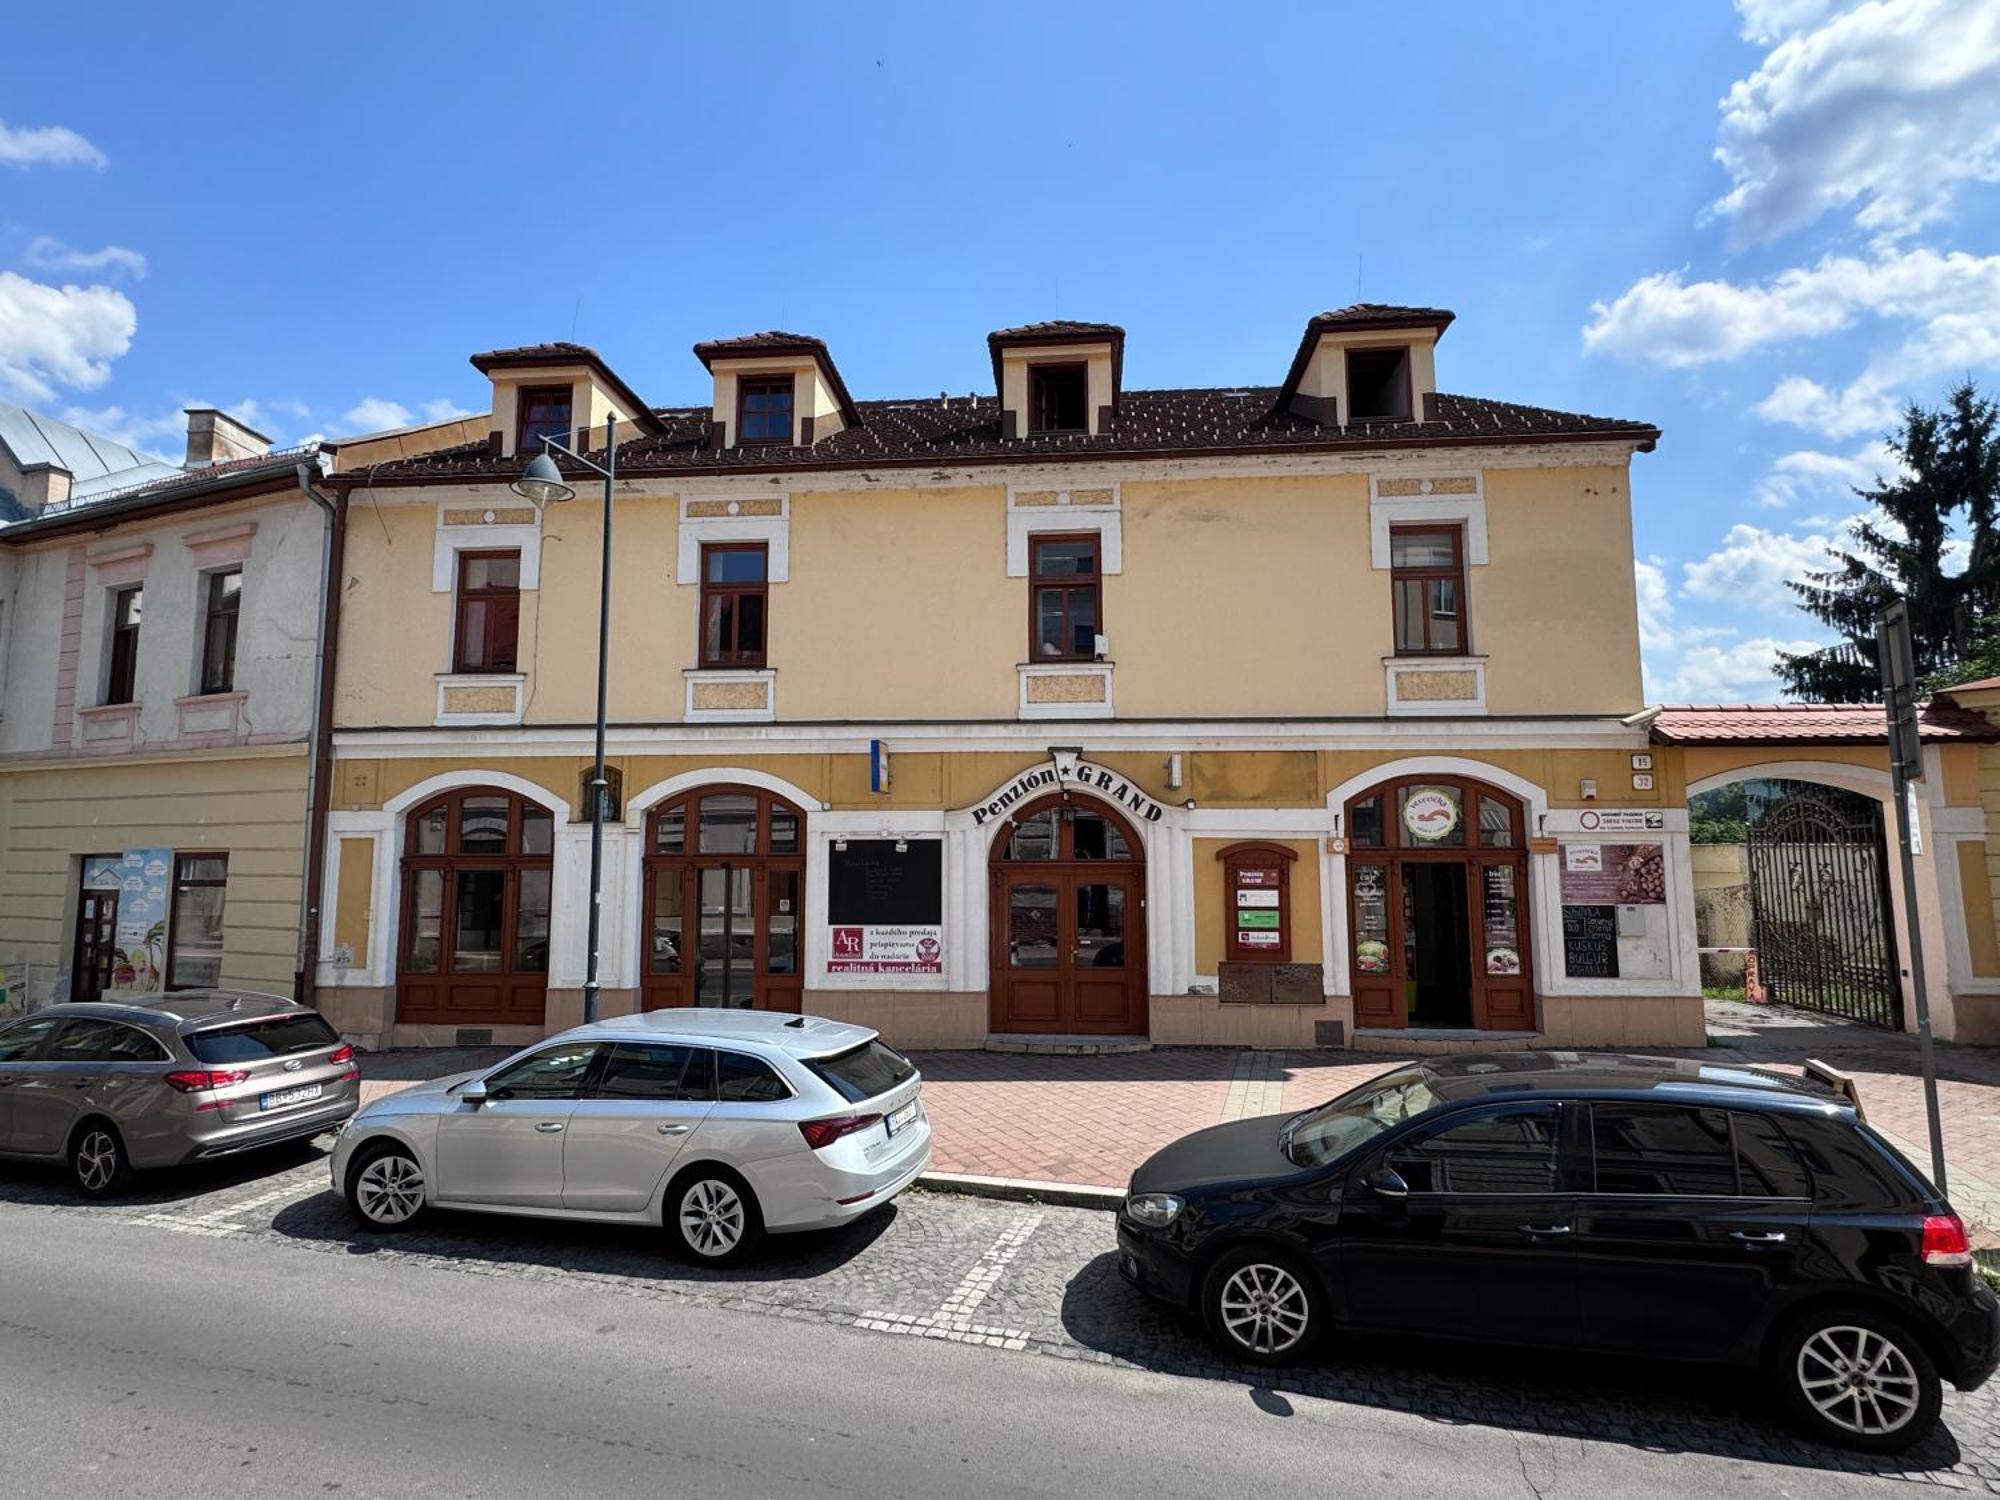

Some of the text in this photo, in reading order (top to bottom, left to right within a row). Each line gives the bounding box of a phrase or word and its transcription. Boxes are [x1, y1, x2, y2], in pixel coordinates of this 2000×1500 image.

[971, 765, 1163, 826] Penzión GRAND
[831, 962, 937, 973] realitná kancelária
